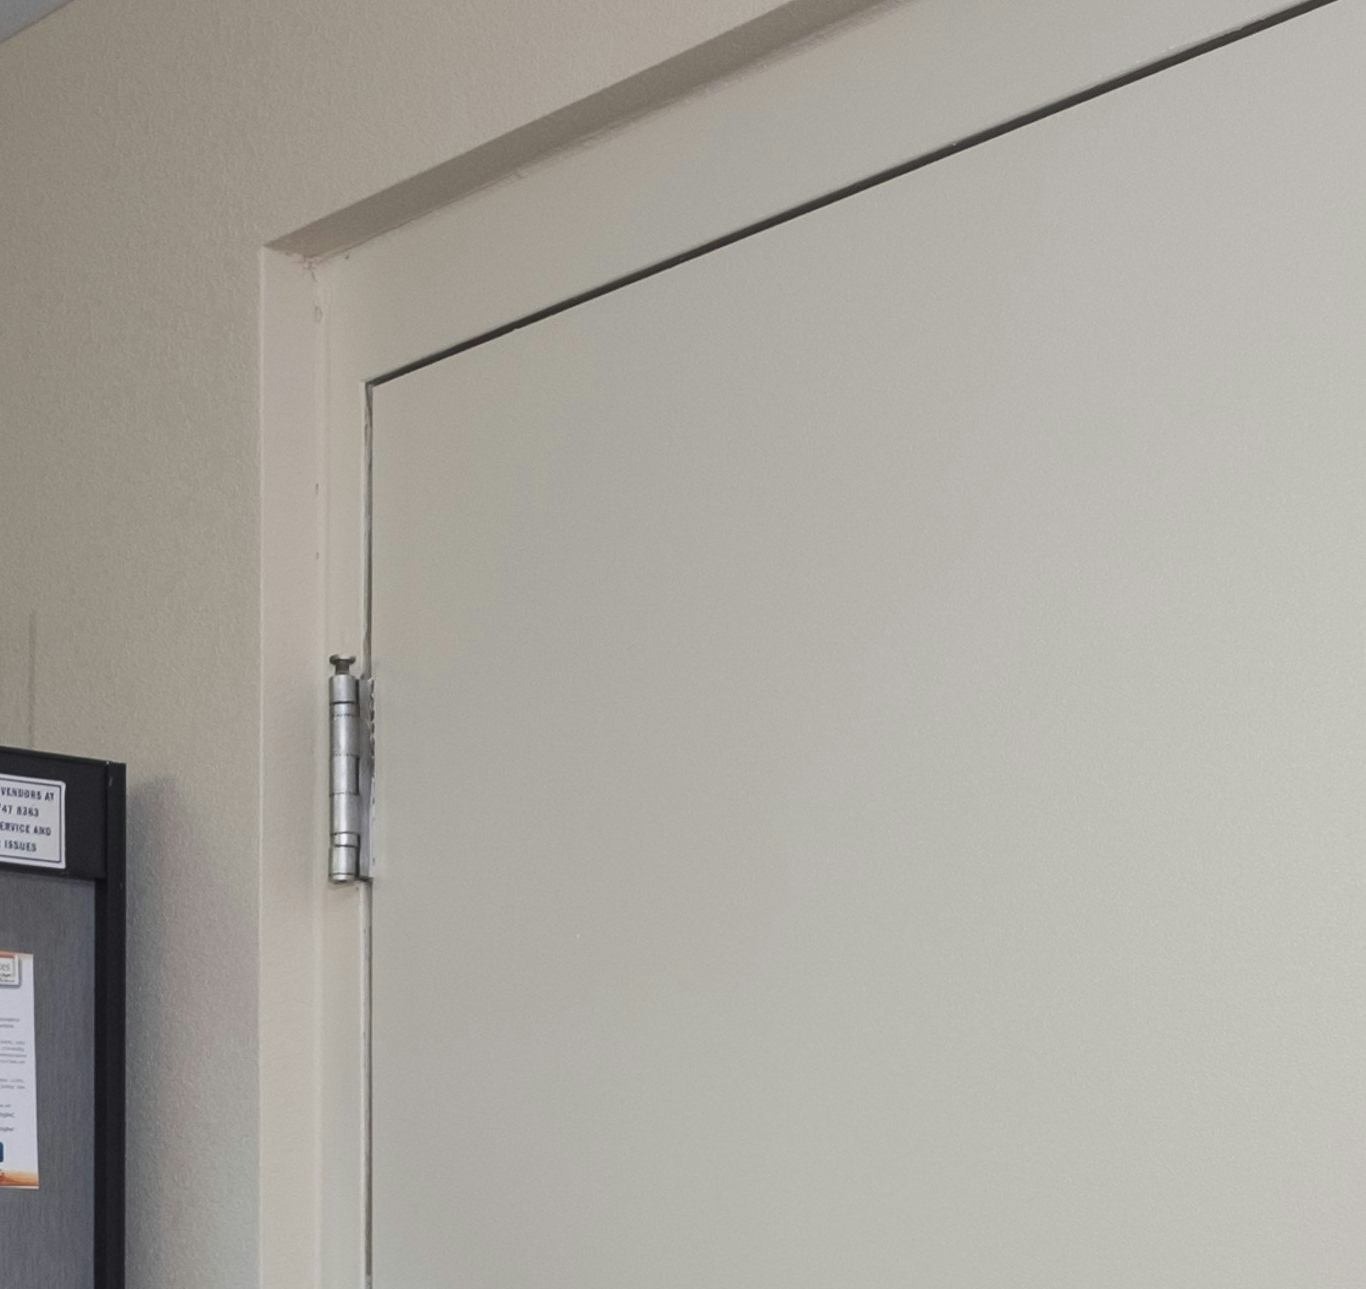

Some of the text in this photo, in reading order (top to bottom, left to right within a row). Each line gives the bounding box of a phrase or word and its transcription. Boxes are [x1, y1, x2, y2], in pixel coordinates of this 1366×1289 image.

[1, 787, 42, 800] VENDORS
[44, 792, 55, 802] AT
[33, 826, 52, 837] AND
[4, 839, 37, 852] ISSUES
